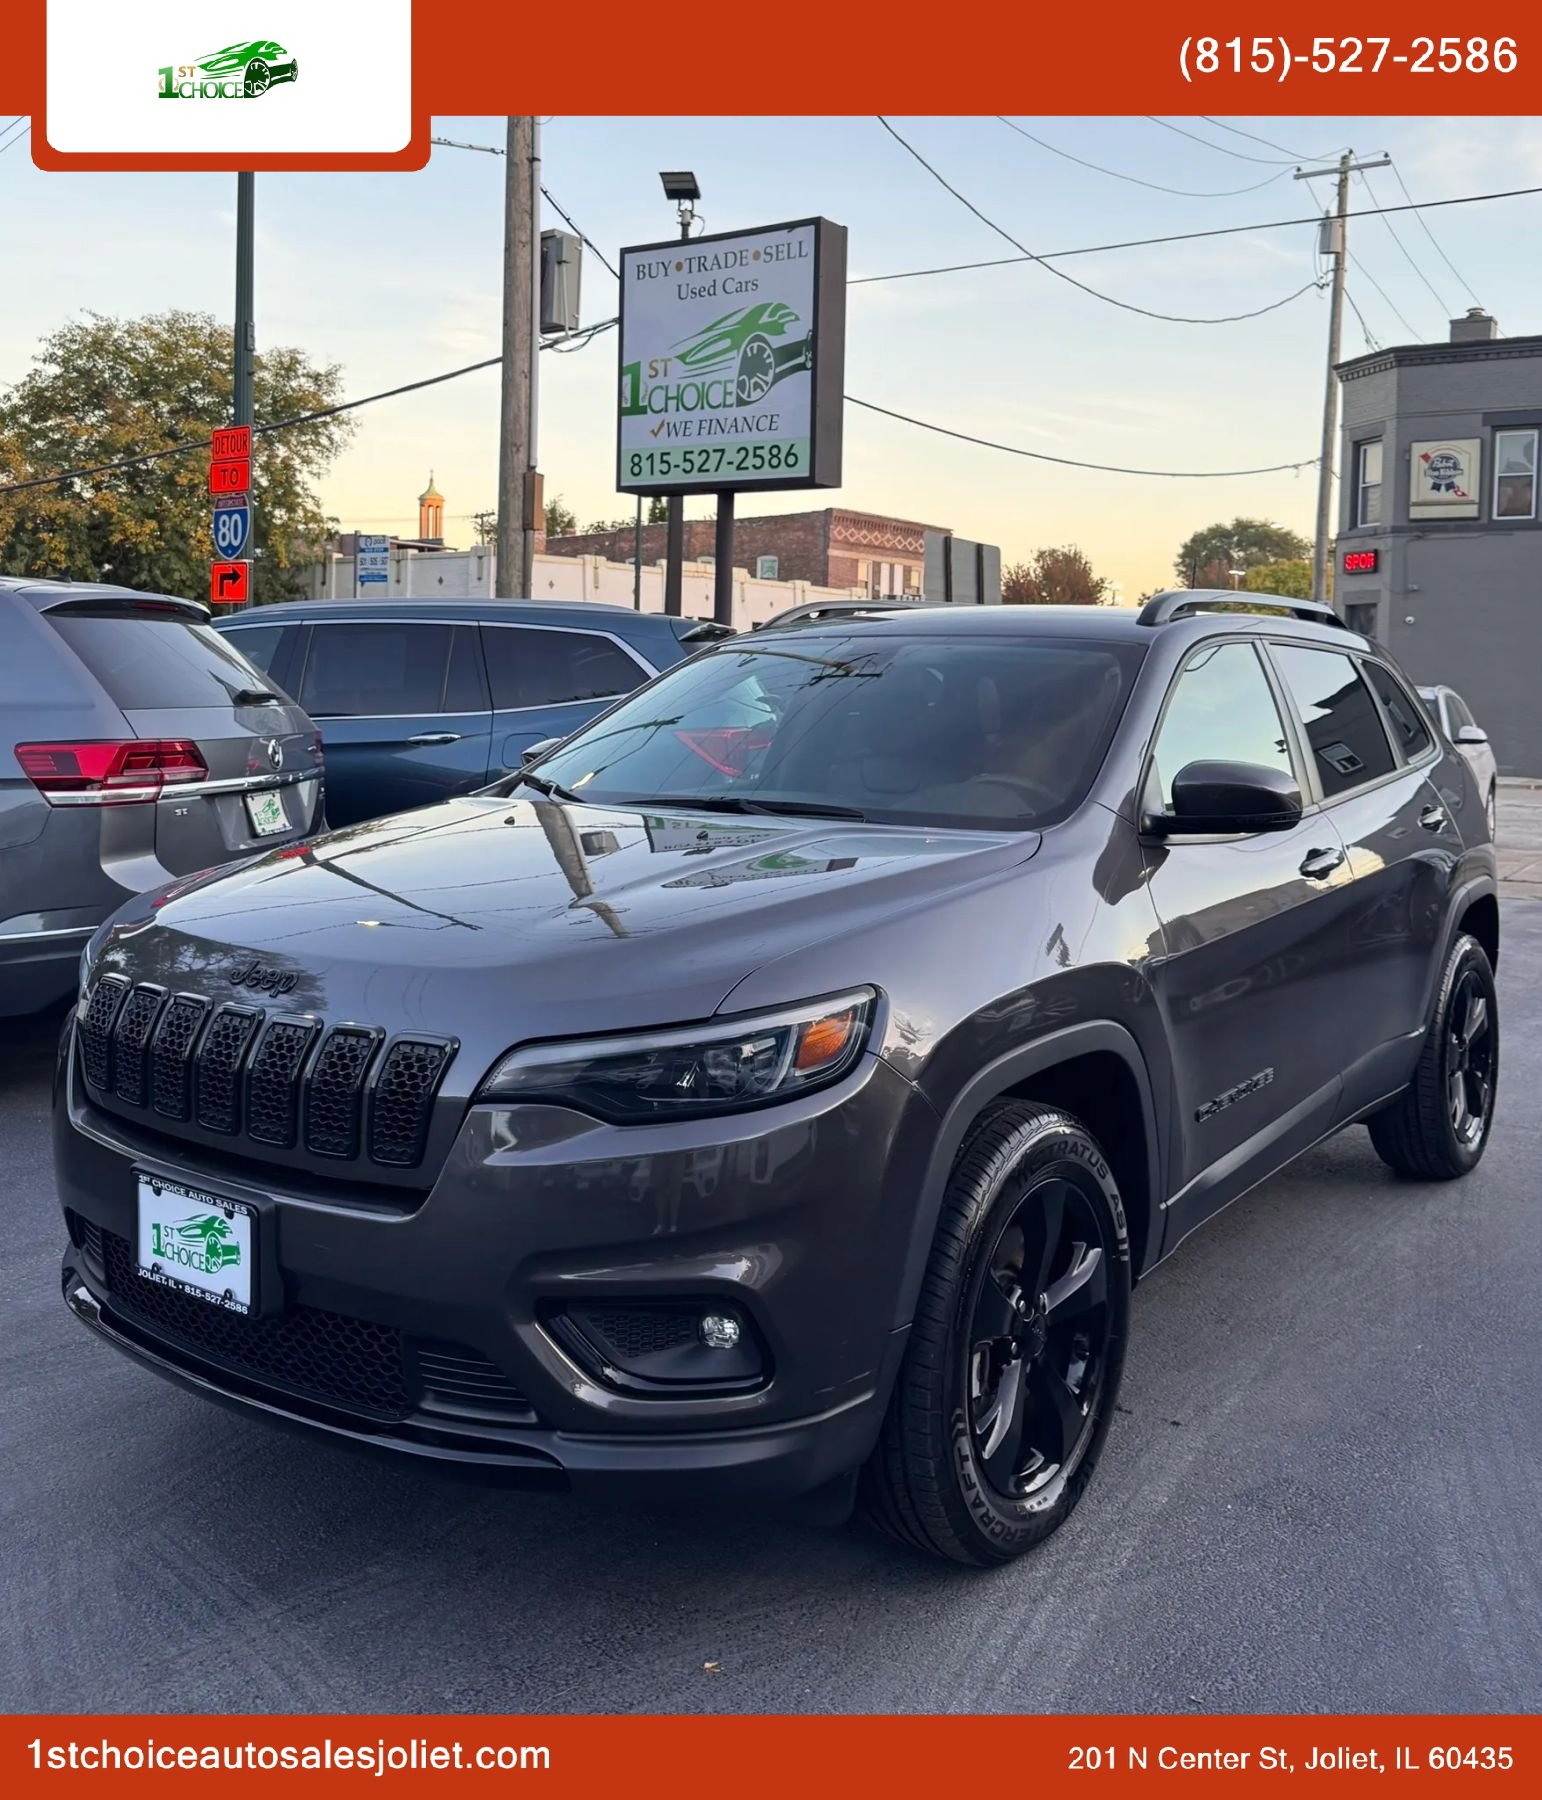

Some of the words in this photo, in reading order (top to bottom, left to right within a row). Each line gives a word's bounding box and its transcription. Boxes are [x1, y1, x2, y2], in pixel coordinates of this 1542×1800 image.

[636, 260, 672, 280] BUY
[684, 249, 749, 275] TRADE
[762, 240, 809, 263] SELL
[677, 280, 717, 300] Used
[722, 278, 759, 295] Cars
[647, 379, 736, 414] CHOICE
[666, 420, 693, 438] WE
[696, 413, 780, 437] FINANCE
[215, 433, 248, 455] DETOUR
[630, 443, 799, 477] 815-527-2586
[221, 467, 239, 486] TO
[218, 513, 242, 548] 80
[230, 960, 300, 998] Jeep
[152, 1179, 187, 1197] CHOICE
[188, 1190, 213, 1205] AUTO
[215, 1199, 248, 1215] SALES
[164, 1242, 205, 1272] CHOICE
[168, 1280, 177, 1289] IL
[184, 1285, 248, 1314] 815-527-2586
